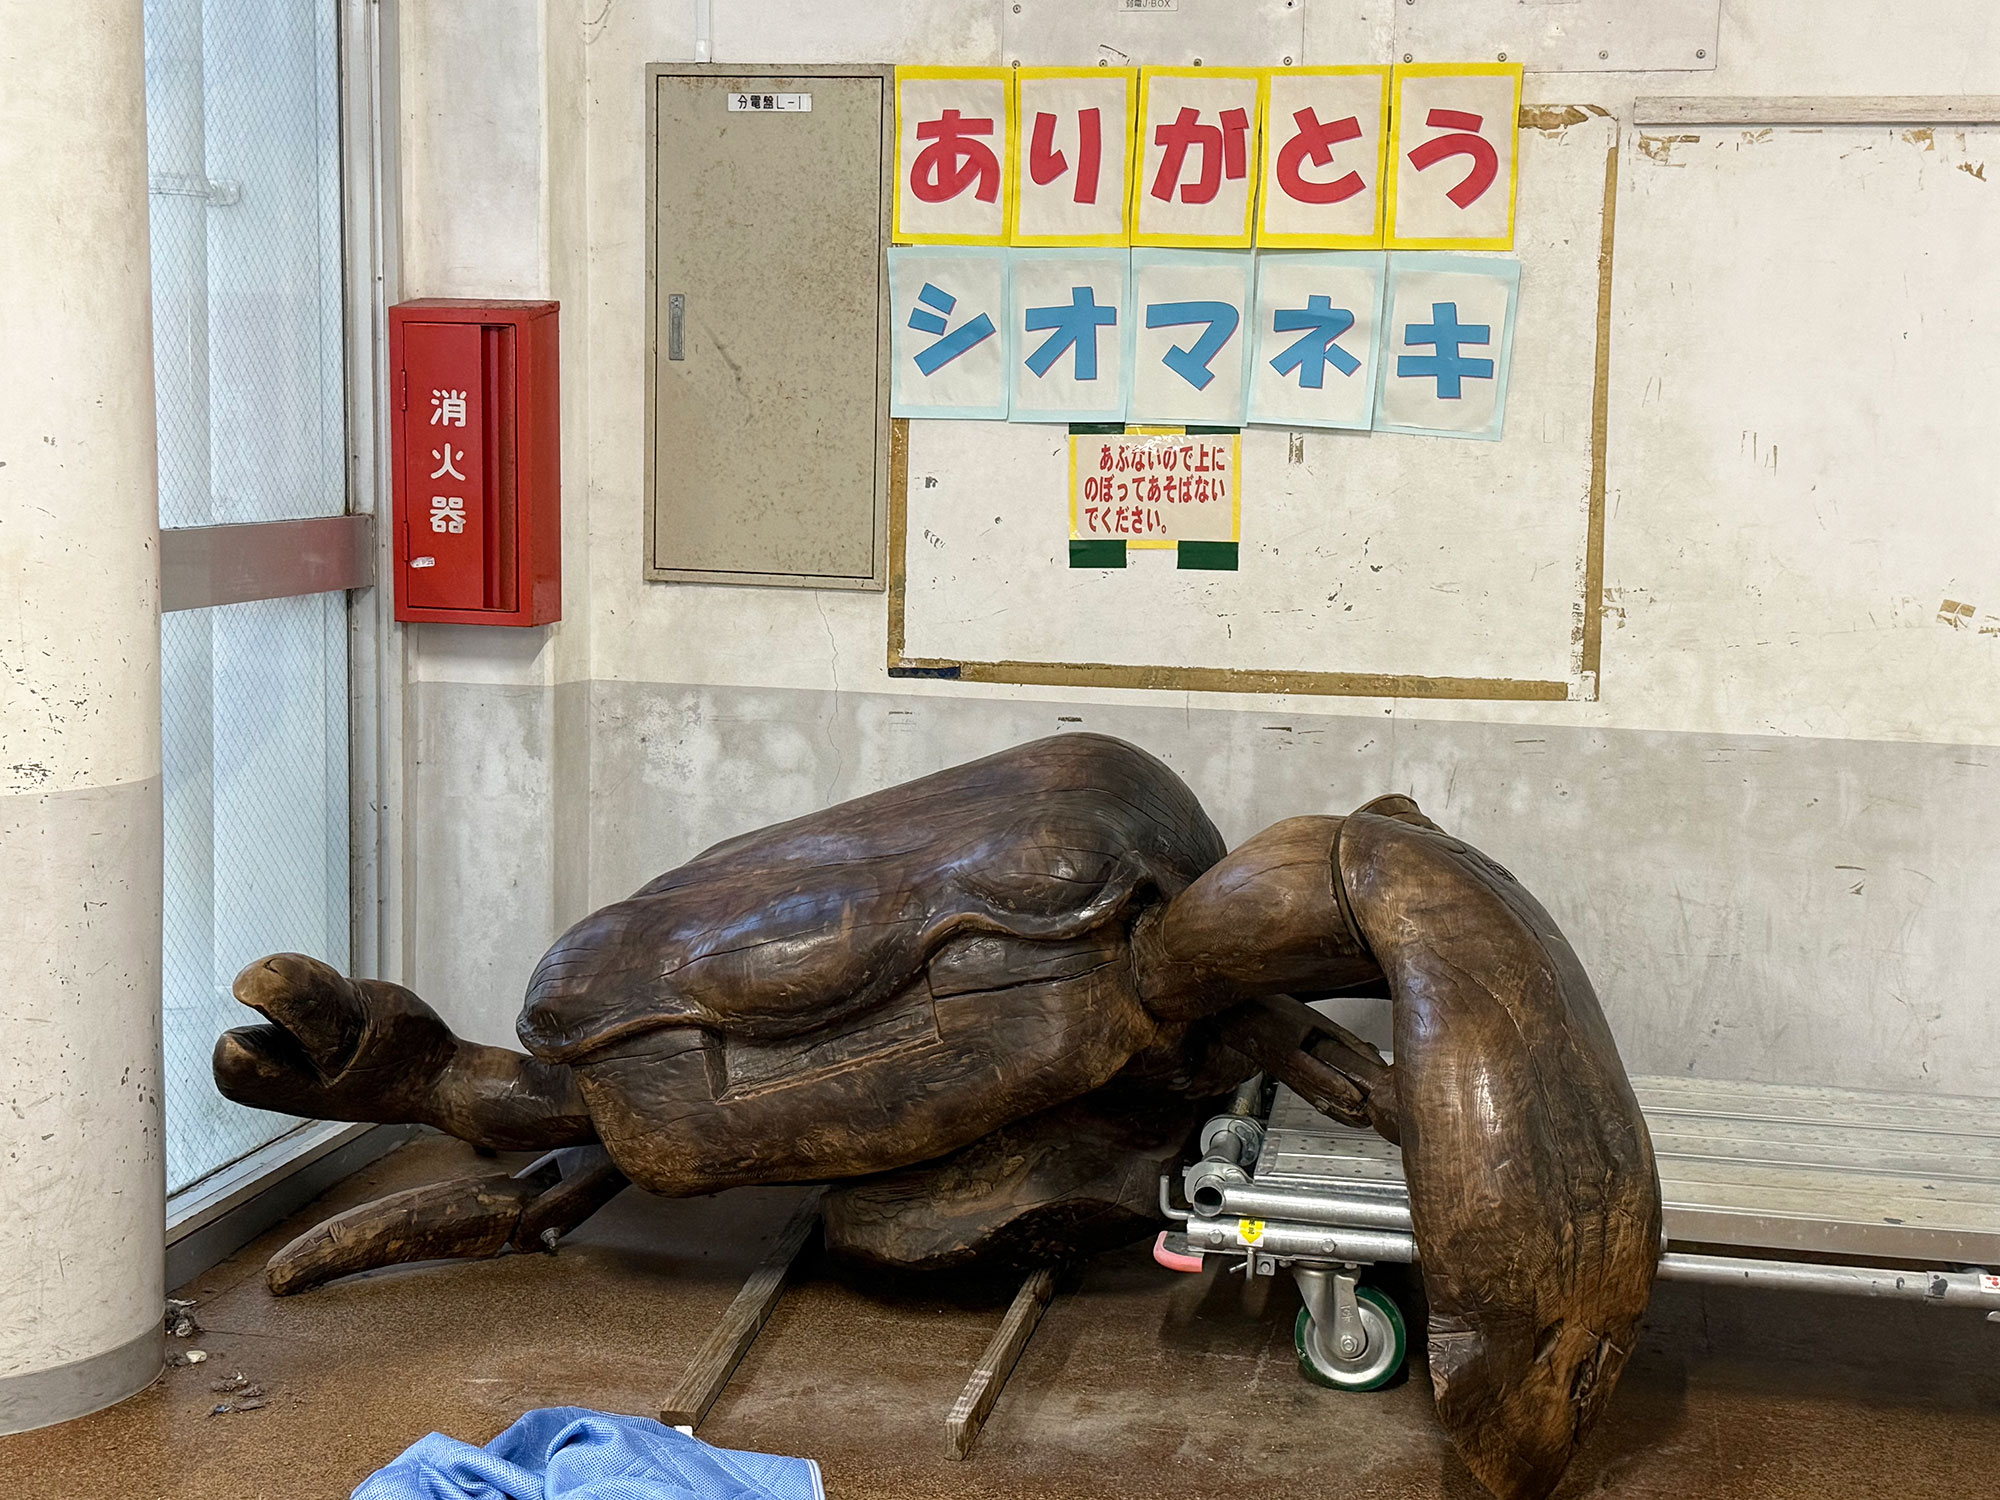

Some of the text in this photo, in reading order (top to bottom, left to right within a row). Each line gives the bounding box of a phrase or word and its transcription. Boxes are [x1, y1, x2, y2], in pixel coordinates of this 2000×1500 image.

[909, 106, 1499, 210] ありがとう
[907, 282, 1495, 400] シオマネキ
[429, 388, 467, 534] 消火器
[1084, 474, 1226, 504] のぼってあそばない
[1099, 443, 1226, 473] あぶないので上に
[1084, 505, 1167, 535] でください。
